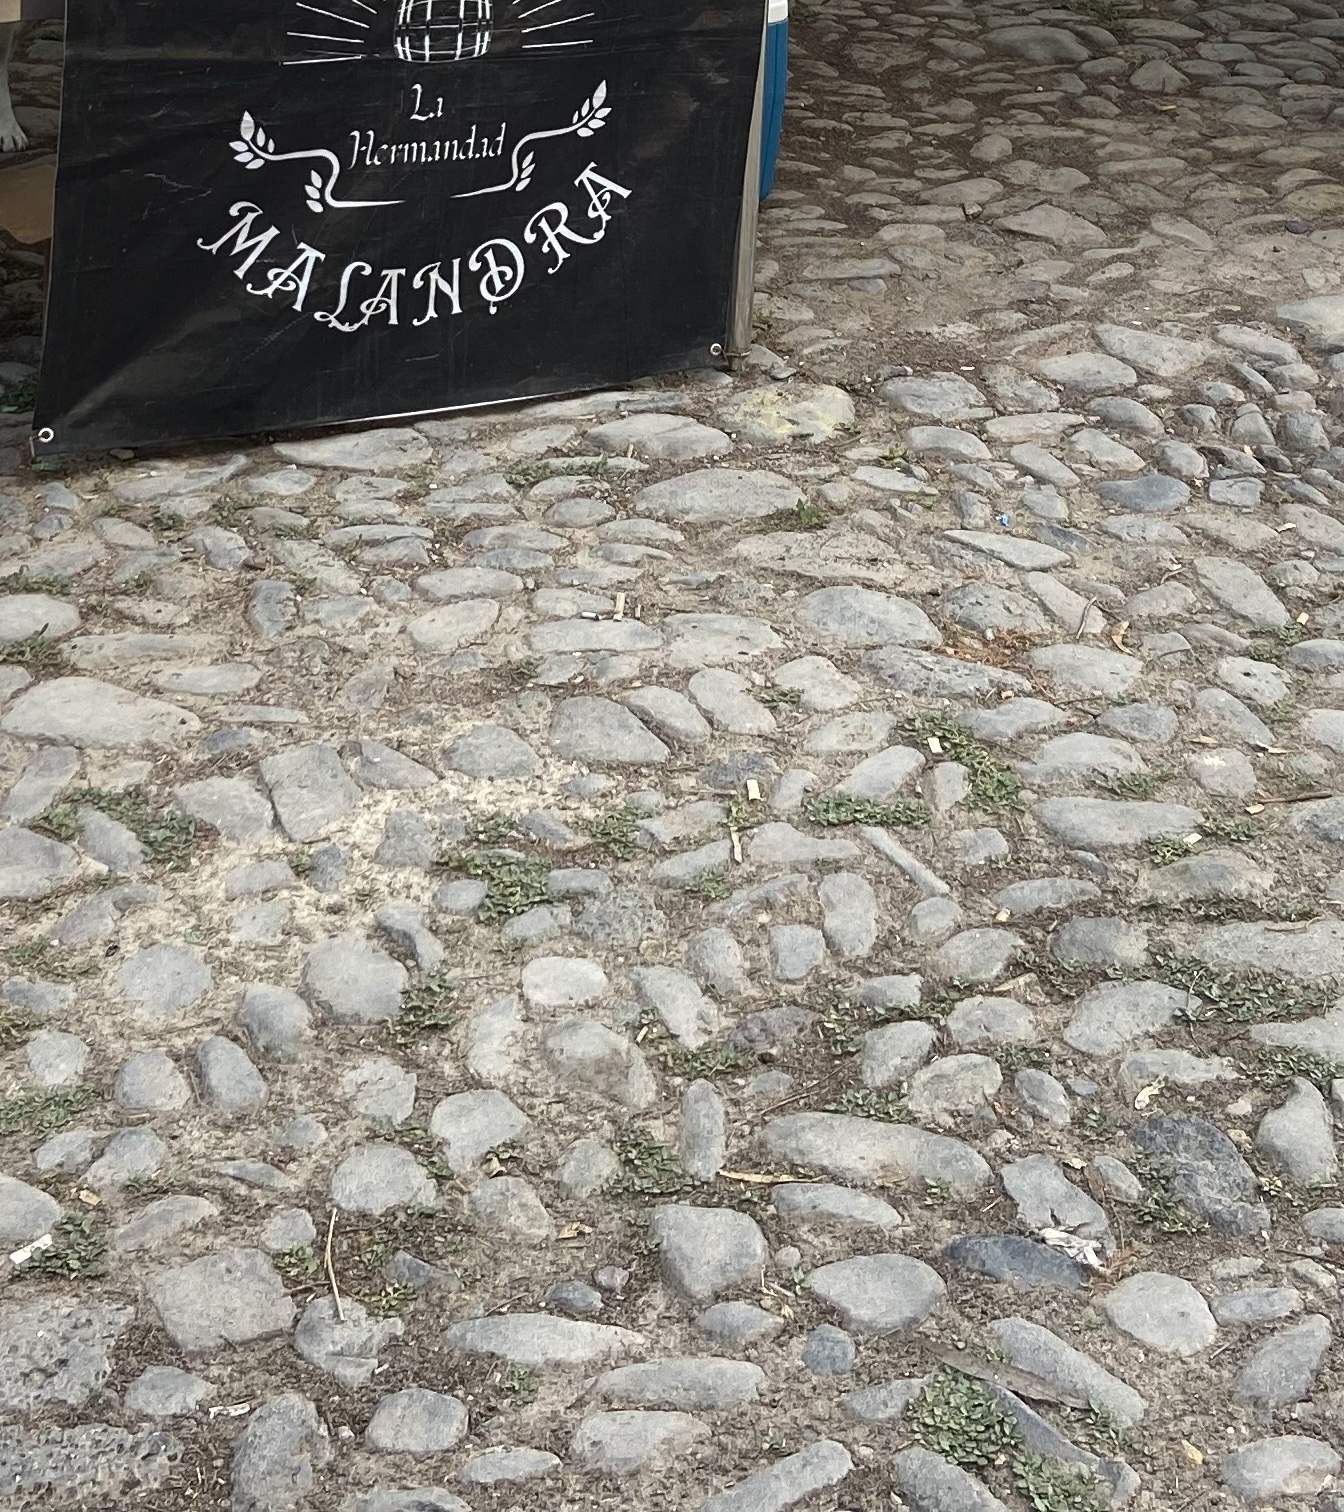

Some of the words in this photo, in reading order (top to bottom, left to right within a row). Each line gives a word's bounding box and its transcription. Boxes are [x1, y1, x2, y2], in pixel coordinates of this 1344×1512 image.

[410, 84, 445, 121] La
[348, 122, 508, 170] Hermandad
[196, 161, 633, 332] MALANDRA
